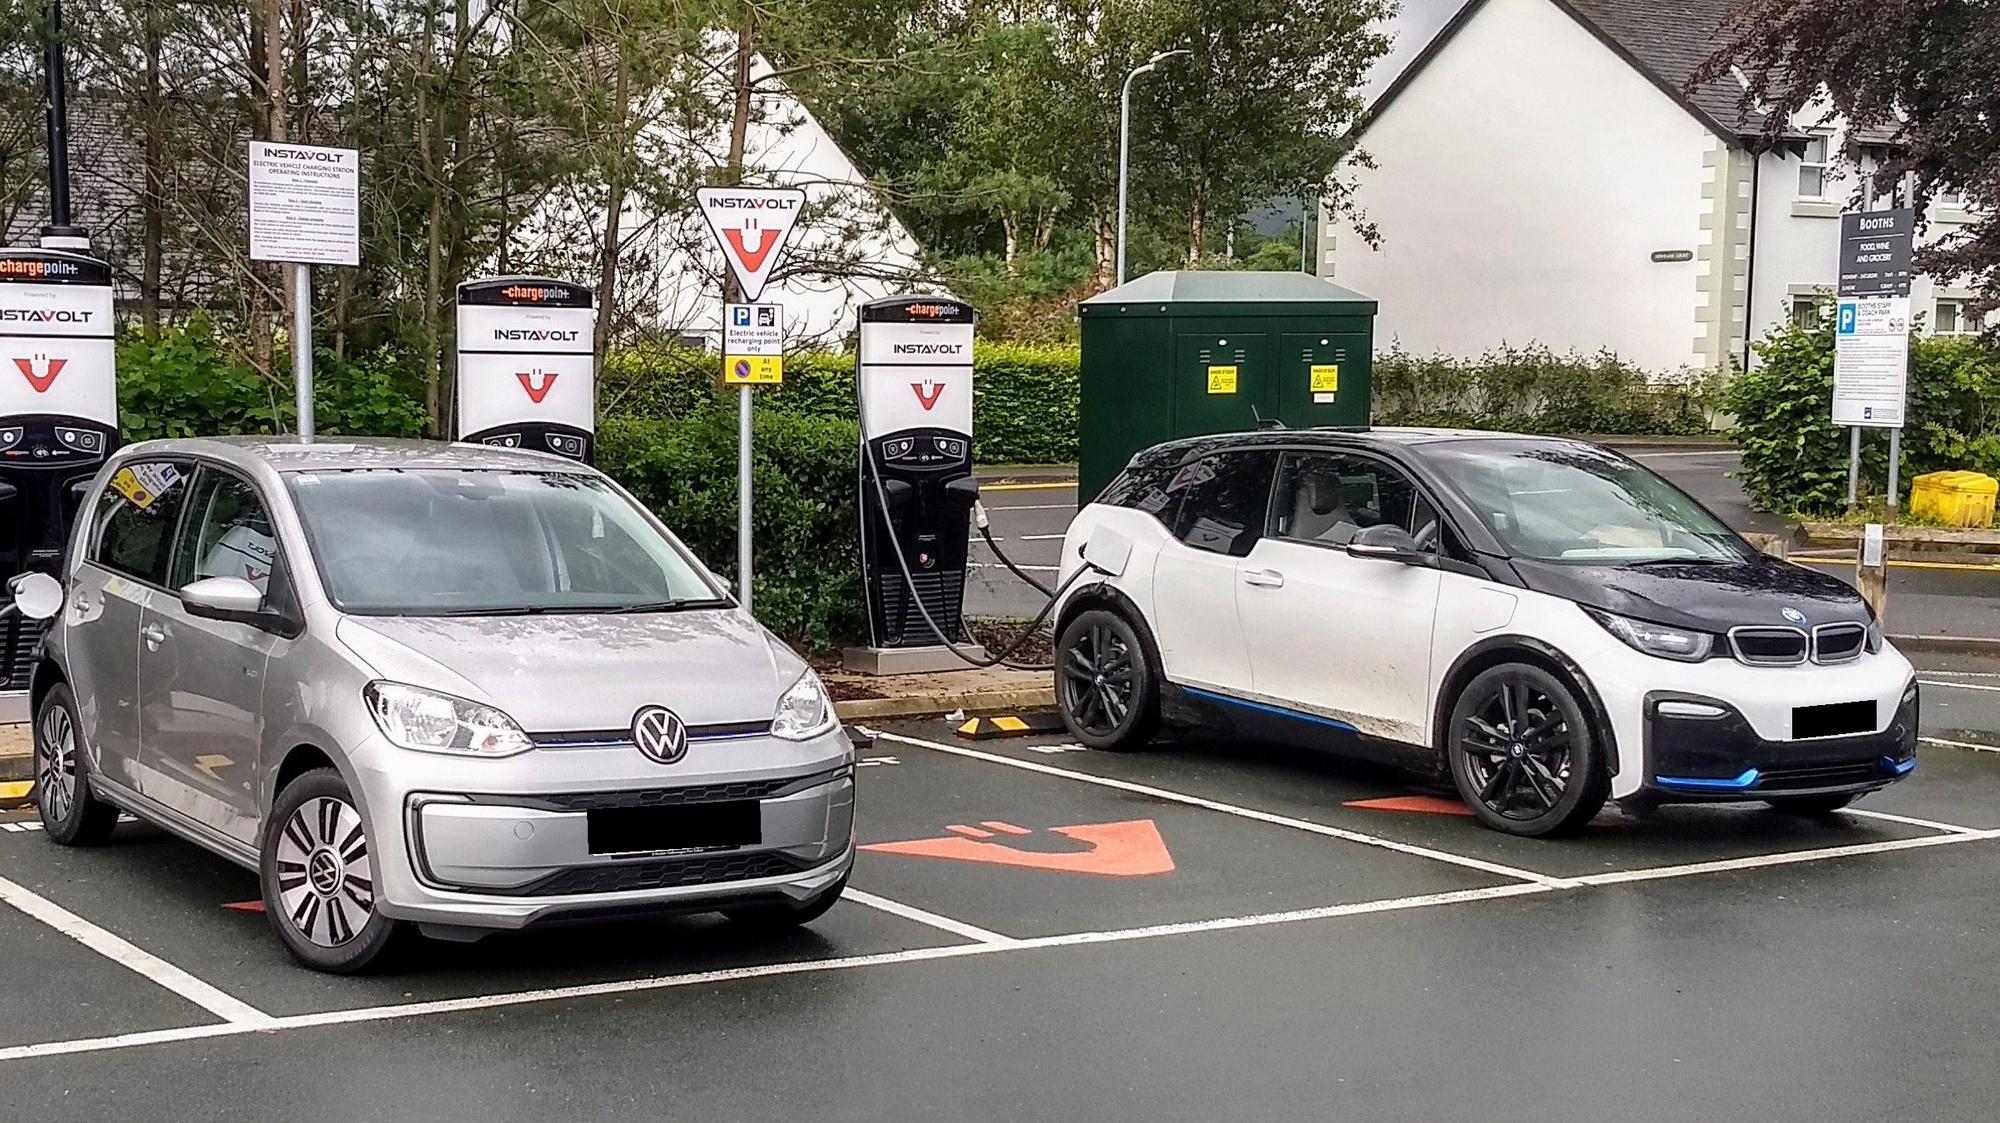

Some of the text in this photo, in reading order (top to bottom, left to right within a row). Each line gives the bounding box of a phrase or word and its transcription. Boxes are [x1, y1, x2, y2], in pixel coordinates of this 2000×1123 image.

[264, 148, 343, 162] INSTAVOLT
[268, 168, 341, 179] OPERATING INSTRUCTIONS
[303, 164, 331, 172] CHARGING
[709, 197, 797, 209] INSTAVOLT
[1860, 217, 1894, 230] BOOTHS
[1856, 254, 1869, 263] AND
[0, 309, 93, 323] STAVOLT
[737, 308, 749, 325] P
[1841, 309, 1853, 331] P
[494, 329, 579, 341] INSTAVOLT
[730, 329, 755, 337] Electric
[894, 344, 963, 354] INSTAVOLT
